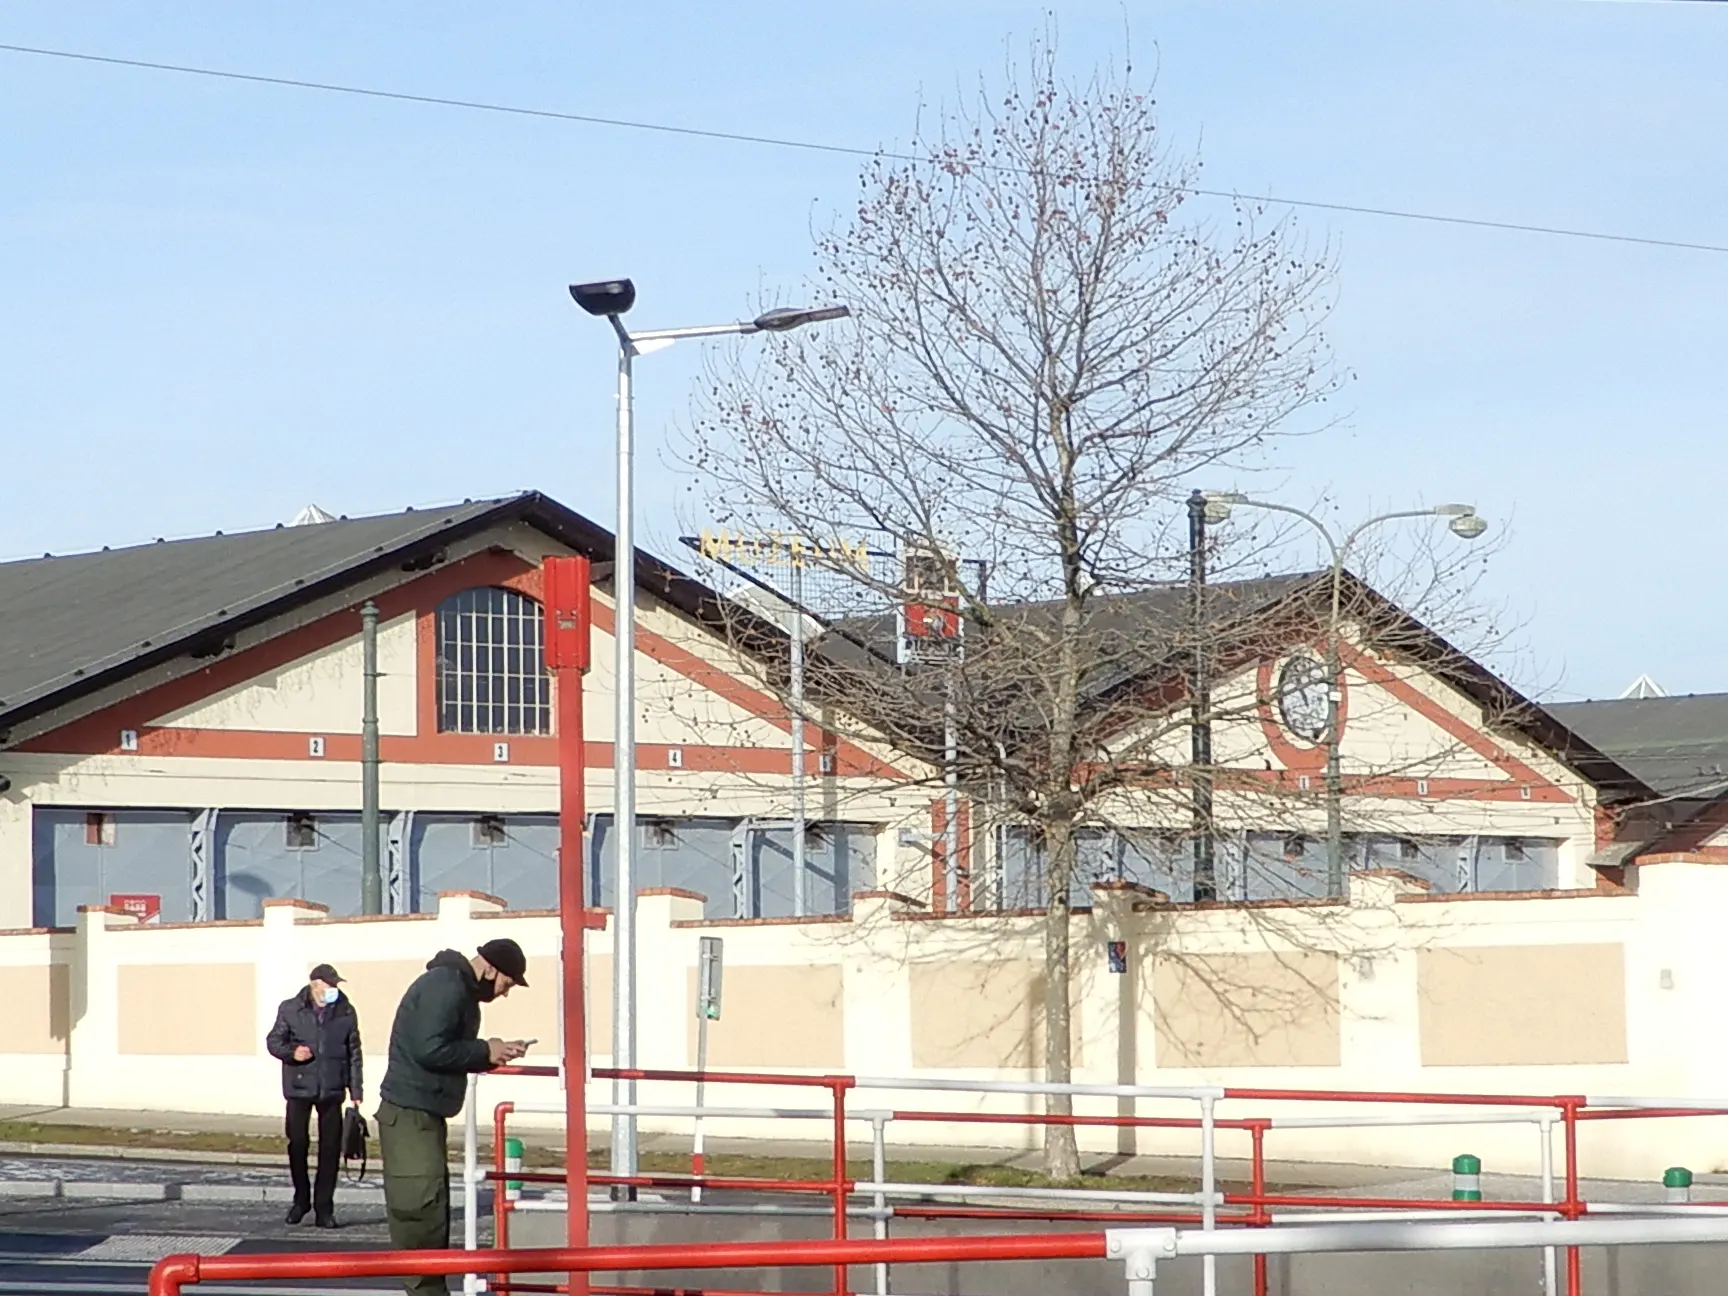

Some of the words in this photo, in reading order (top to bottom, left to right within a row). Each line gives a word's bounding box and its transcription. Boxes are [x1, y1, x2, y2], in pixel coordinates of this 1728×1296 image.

[313, 739, 319, 754] 2
[498, 745, 503, 758] 3
[672, 751, 678, 764] 4
